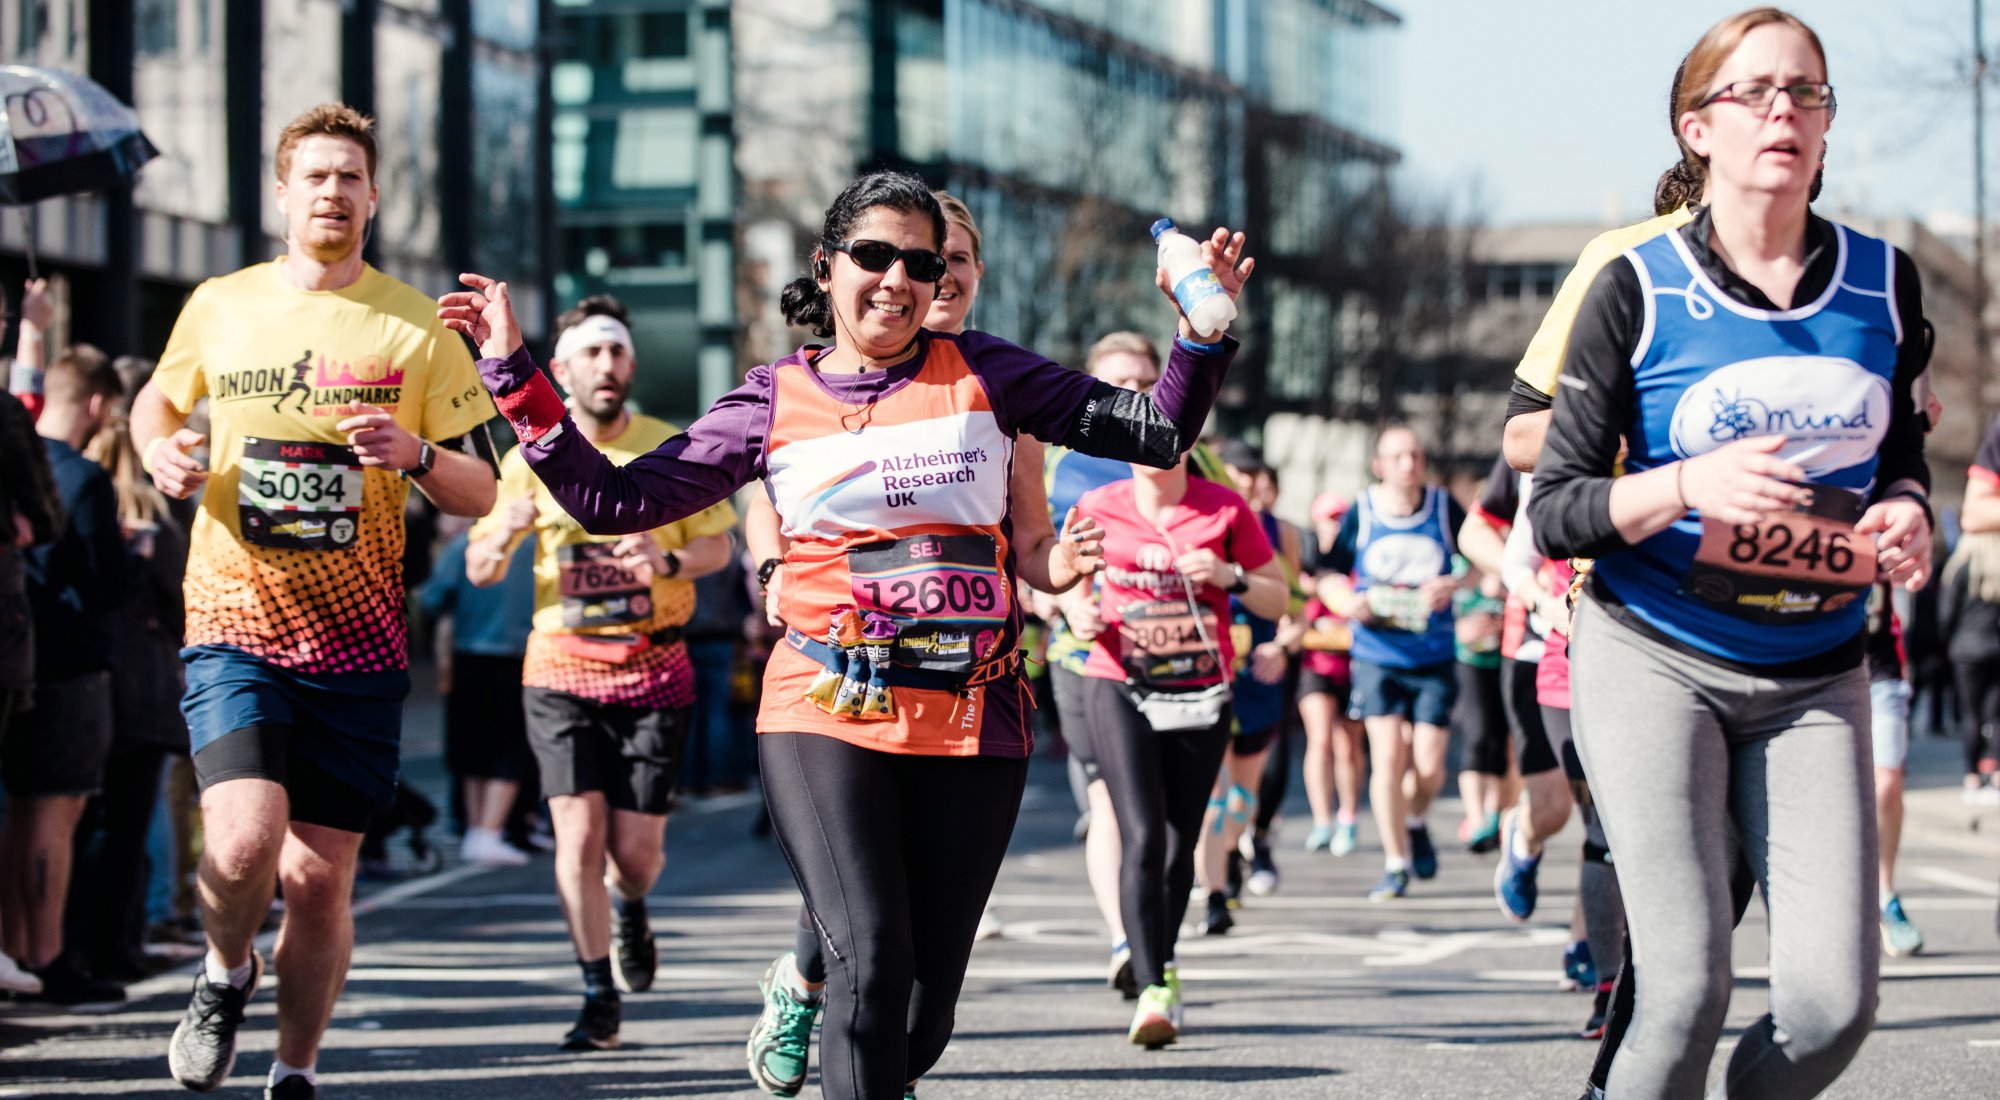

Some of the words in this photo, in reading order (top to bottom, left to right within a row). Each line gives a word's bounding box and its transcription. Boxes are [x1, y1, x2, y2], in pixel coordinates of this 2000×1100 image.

[314, 387, 402, 406] LANDMARKS
[1079, 398, 1097, 437] Ailzos
[1766, 400, 1872, 432] mind
[280, 445, 326, 459] MARK
[881, 447, 988, 473] Alzheimer's
[257, 470, 346, 503] 5034
[882, 465, 976, 491] Research
[885, 491, 917, 508] UK
[909, 541, 942, 559] SEJ
[1729, 524, 1853, 574] 8246
[863, 574, 996, 614] 12609
[899, 637, 930, 648] LONDON
[961, 704, 976, 730] The
